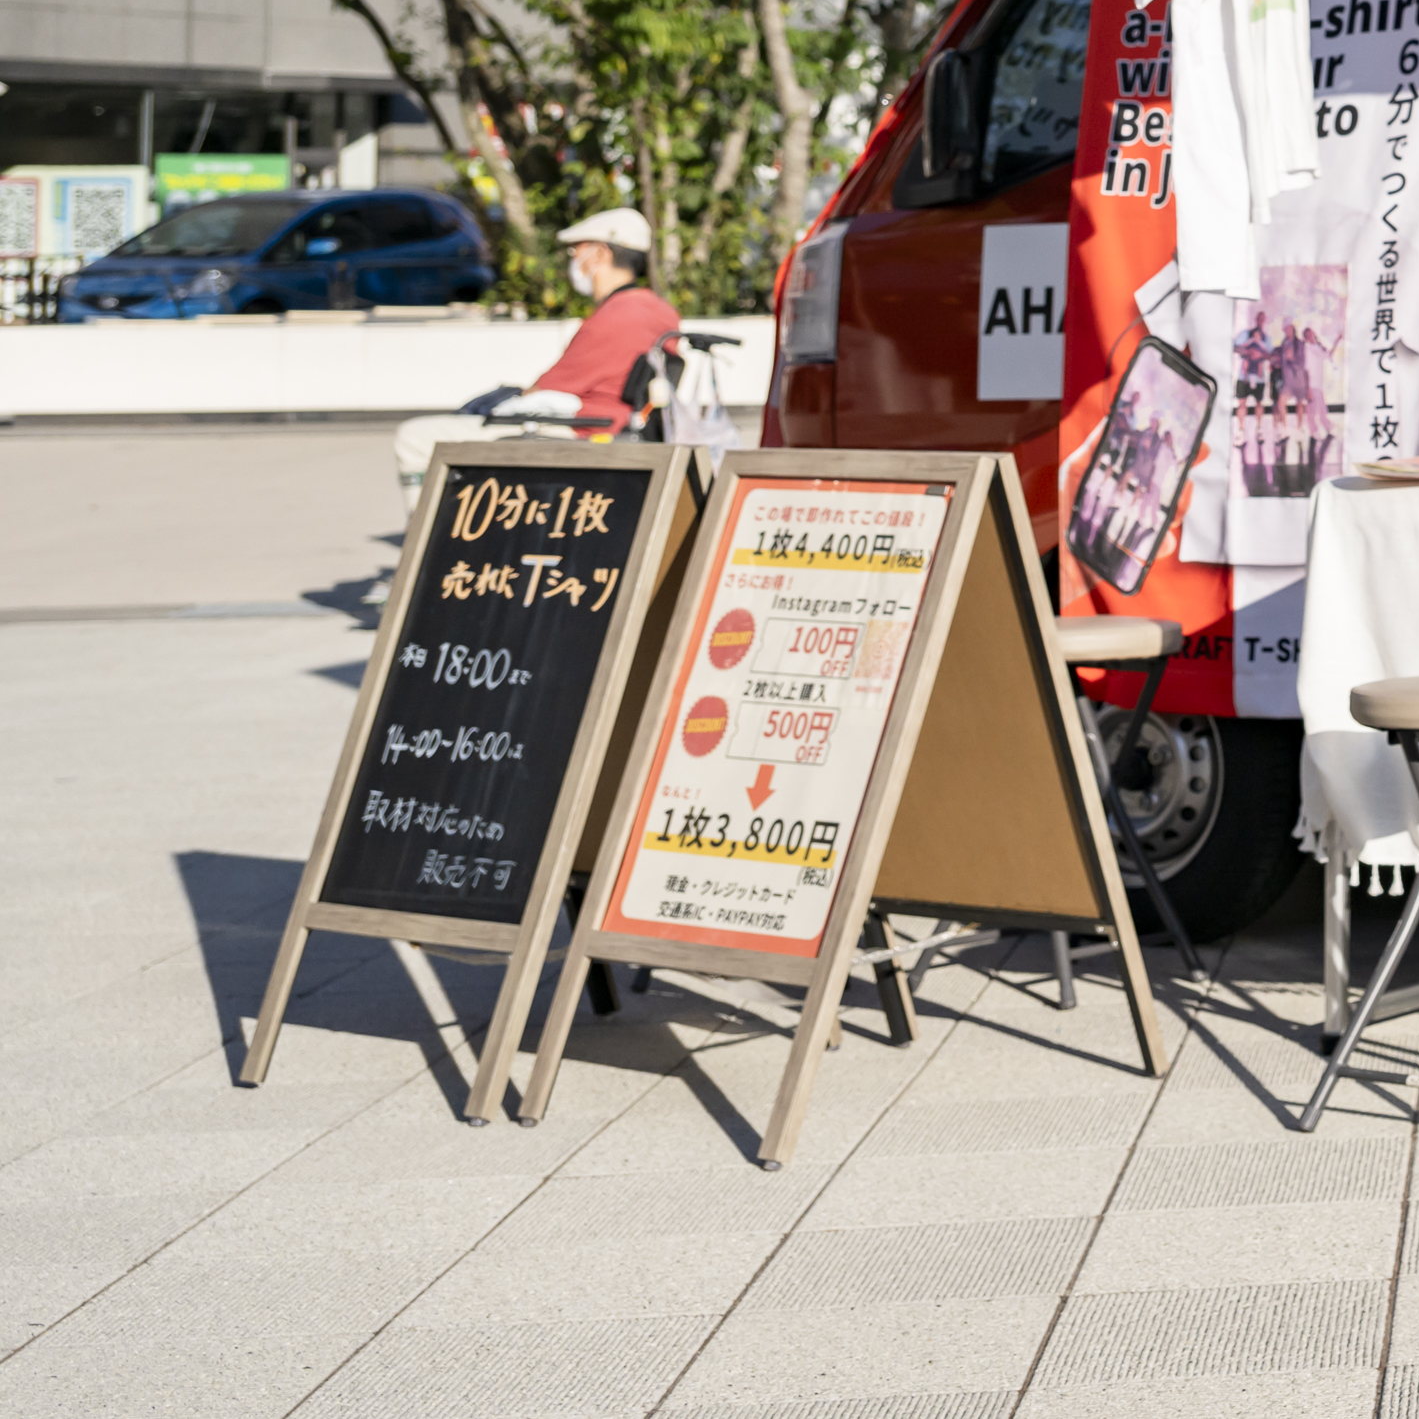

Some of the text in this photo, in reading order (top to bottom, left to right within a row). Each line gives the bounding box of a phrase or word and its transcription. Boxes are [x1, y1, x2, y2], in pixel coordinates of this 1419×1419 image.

[1316, 101, 1359, 139] to
[983, 286, 1065, 335] AH
[449, 476, 614, 543] 10分に1枚
[440, 553, 621, 613] 売れたTシャツ
[787, 624, 861, 659] 100円
[820, 658, 851, 678] OFF
[762, 708, 835, 746] 500円
[794, 744, 824, 764] OFF
